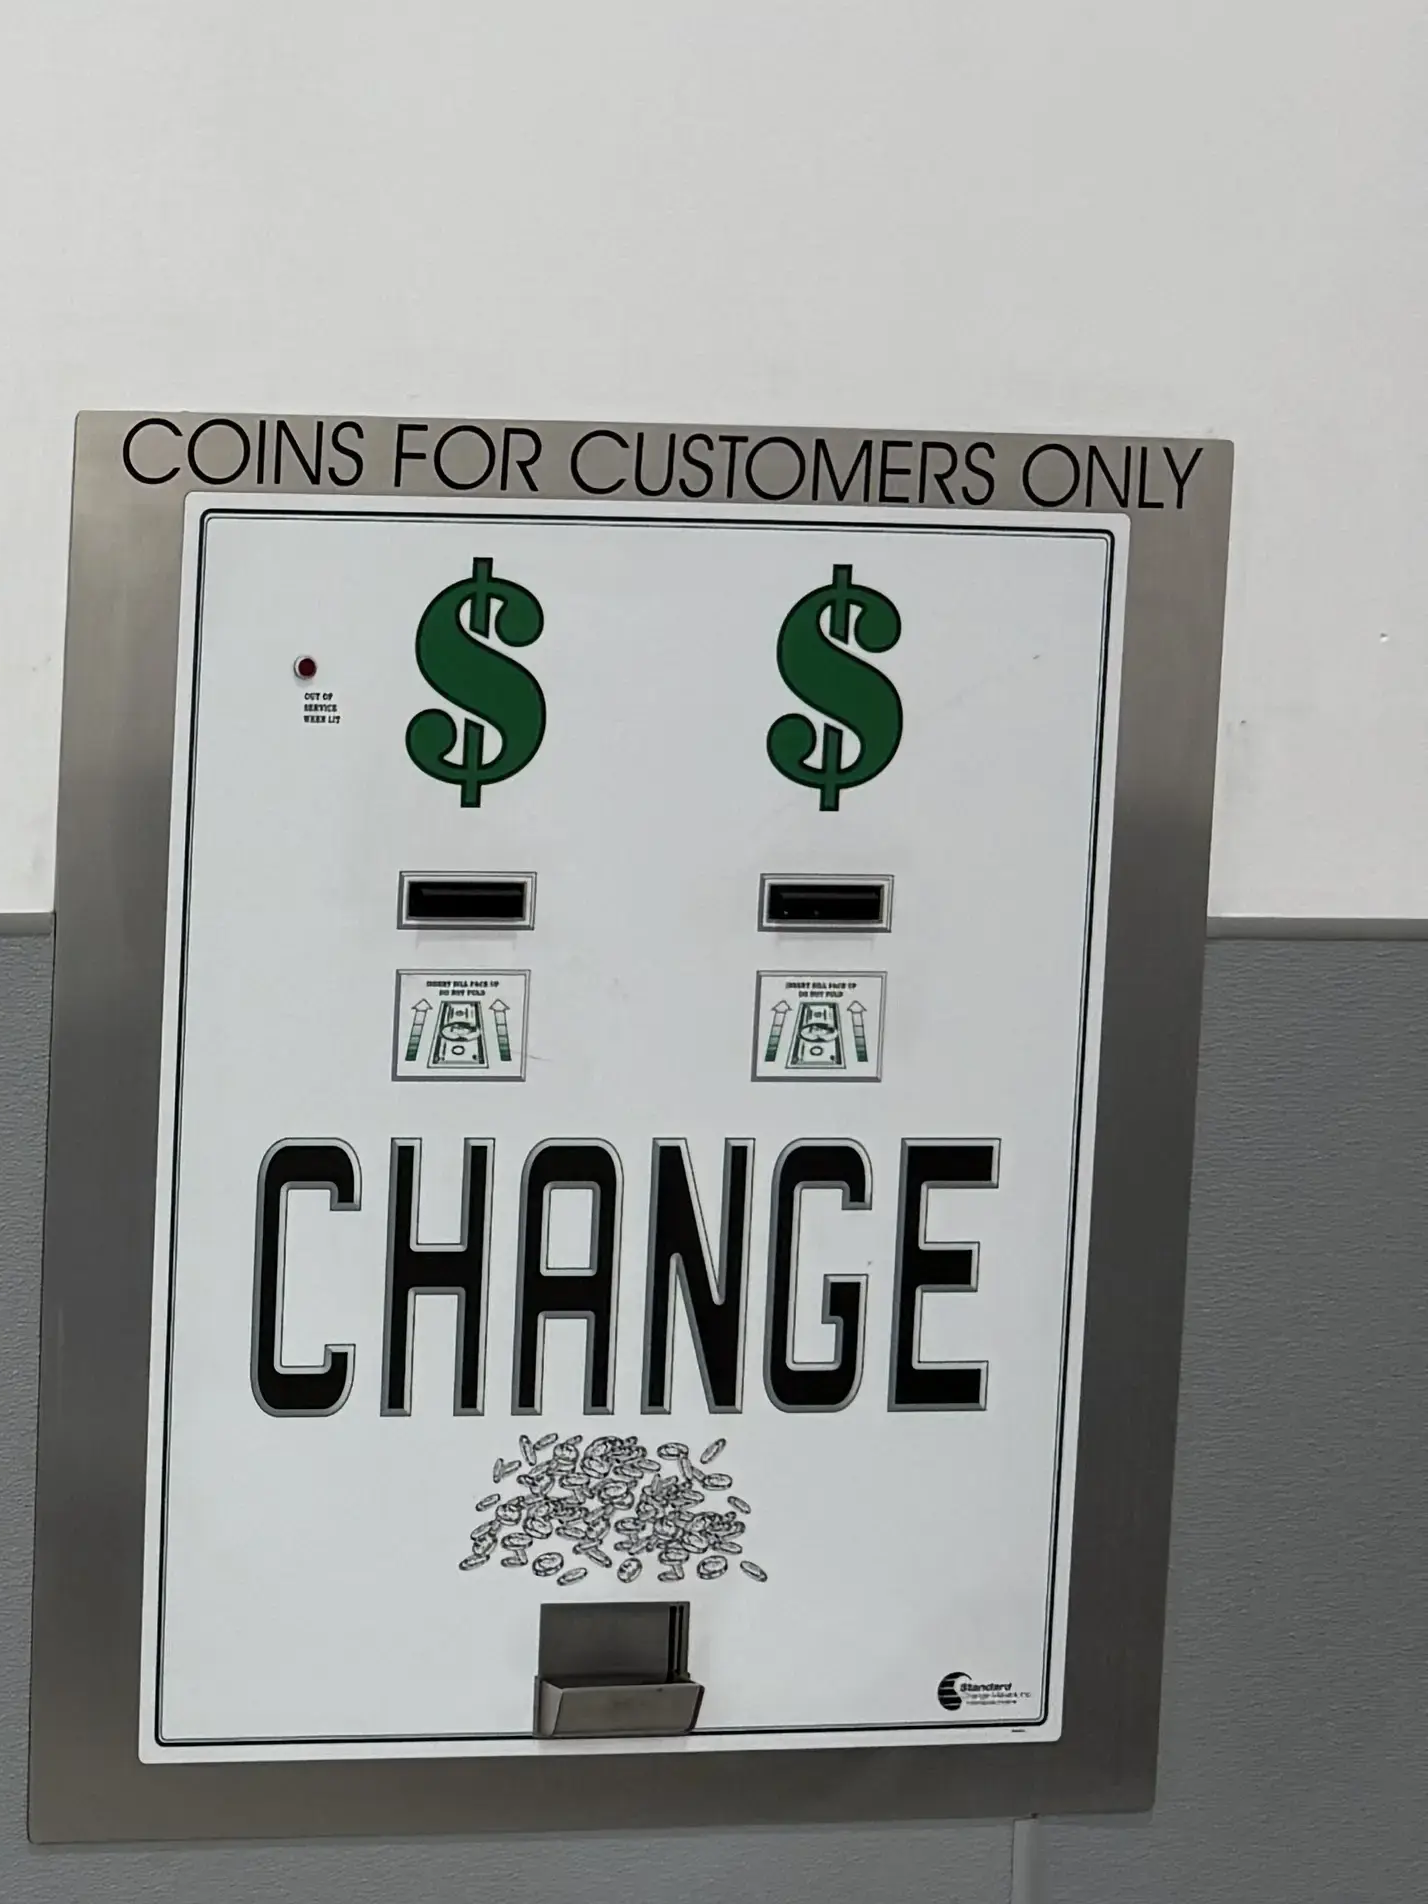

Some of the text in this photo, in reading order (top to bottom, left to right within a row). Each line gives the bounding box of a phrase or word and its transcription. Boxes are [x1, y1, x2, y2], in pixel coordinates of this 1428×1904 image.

[122, 417, 1204, 510] COINS FOR CUSTOMERS ONLY
[404, 556, 904, 813] $ $
[249, 1137, 1003, 1418] CHANGE
